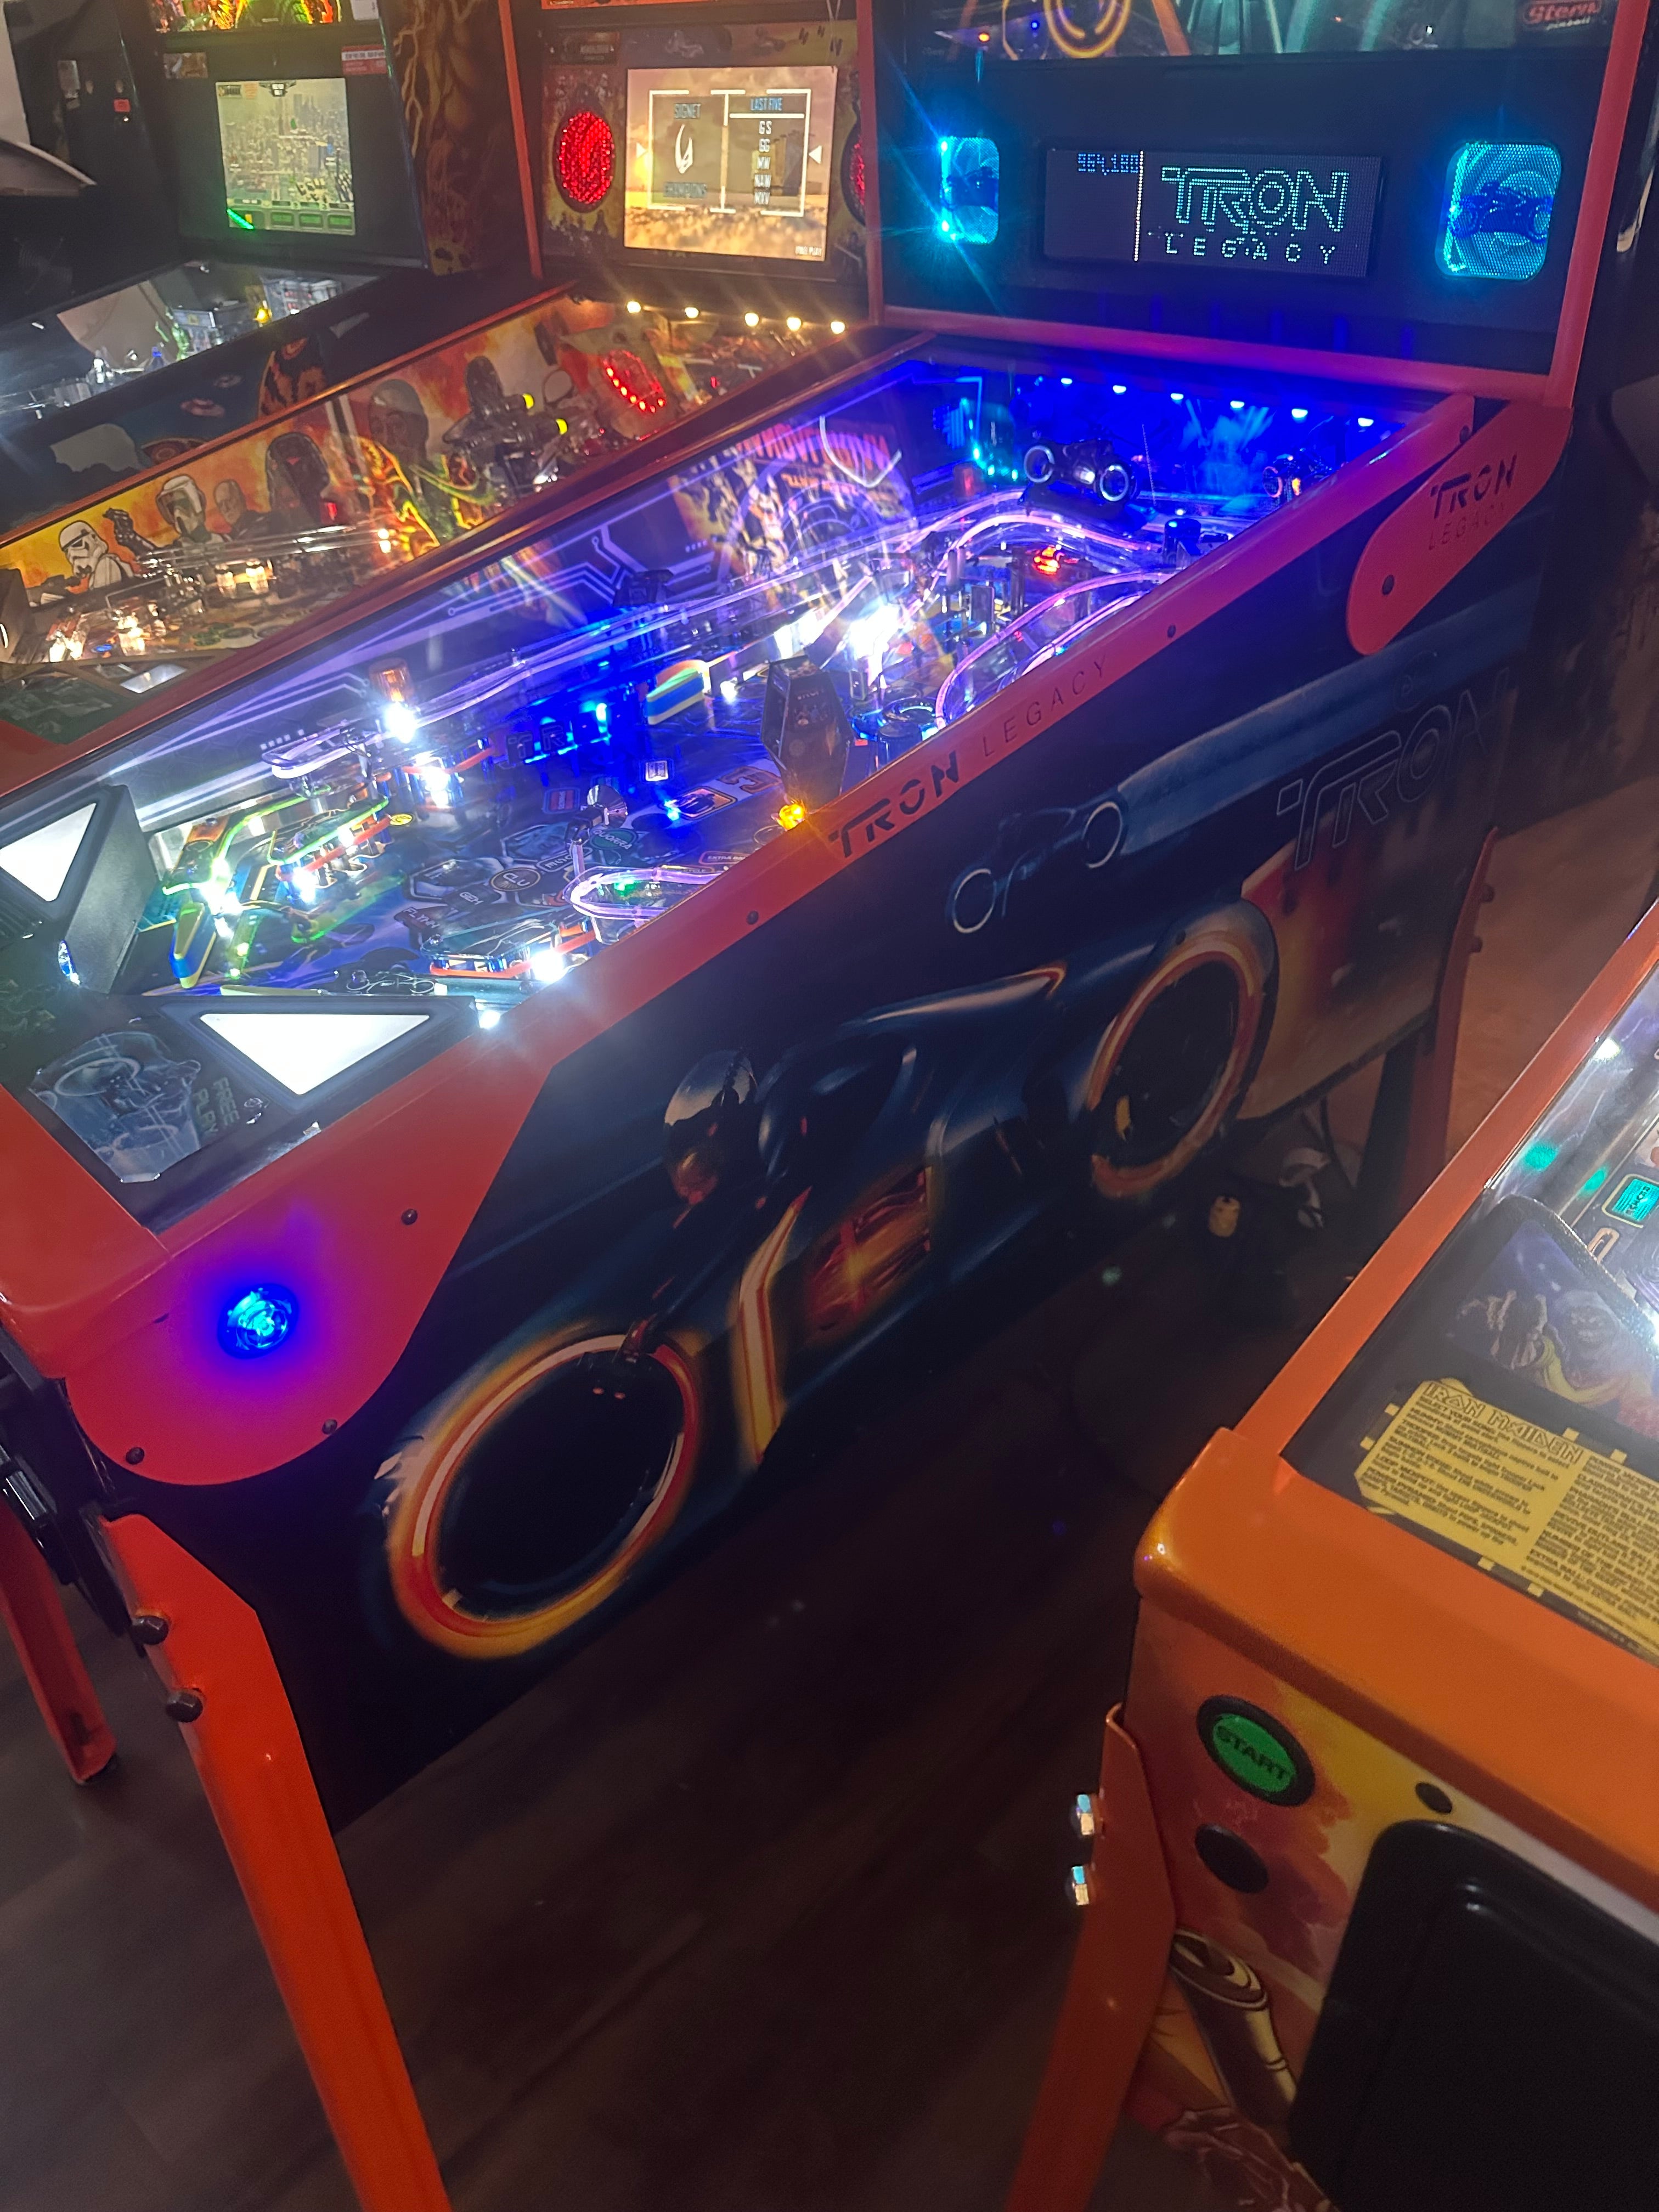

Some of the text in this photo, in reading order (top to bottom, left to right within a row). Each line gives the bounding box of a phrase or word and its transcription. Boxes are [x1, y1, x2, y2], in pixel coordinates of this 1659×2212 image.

[1527, 2, 1598, 24] Stern
[750, 98, 767, 111] LAST
[759, 120, 772, 134] GS
[1161, 166, 1350, 234] TRON
[1165, 235, 1335, 264] LEGACY
[1430, 453, 1517, 519] TRON
[828, 655, 1107, 857] TRON LEGACY
[1276, 667, 1510, 871] TRON
[592, 828, 633, 850] QUORRA
[503, 872, 531, 887] CLU
[459, 891, 484, 906] GEM
[403, 907, 441, 929] FLYNN
[212, 1076, 240, 1126] FREE
[1422, 1381, 1486, 1419] IRON
[1487, 1408, 1584, 1465] MAIDEN
[1217, 1726, 1286, 1780] START
